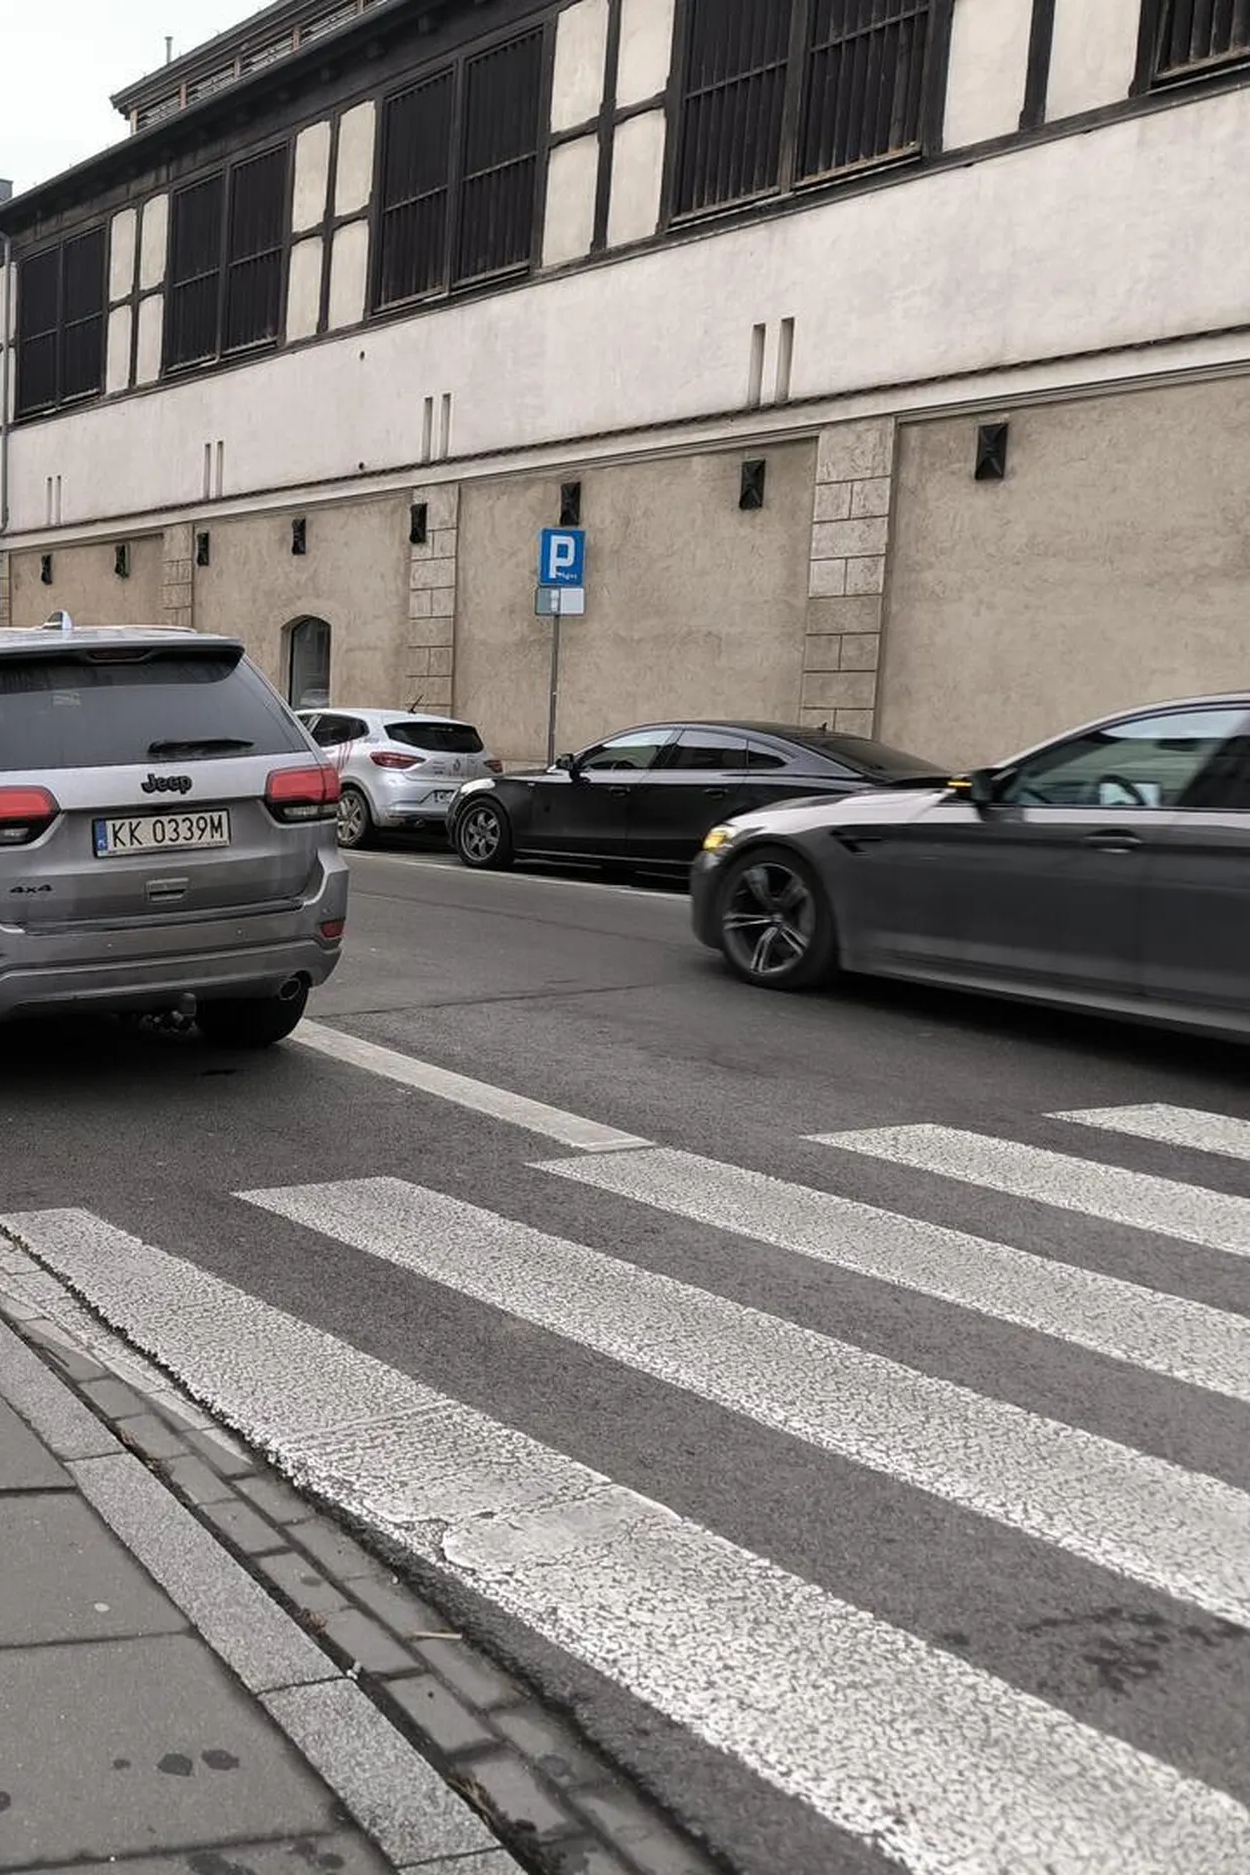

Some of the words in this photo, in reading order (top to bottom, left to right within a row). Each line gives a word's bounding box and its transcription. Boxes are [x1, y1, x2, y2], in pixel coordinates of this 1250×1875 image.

[549, 535, 576, 578] P
[141, 773, 193, 795] Jeep
[112, 820, 143, 848] KK
[152, 814, 224, 844] 0339M
[9, 884, 52, 893] 4x4
